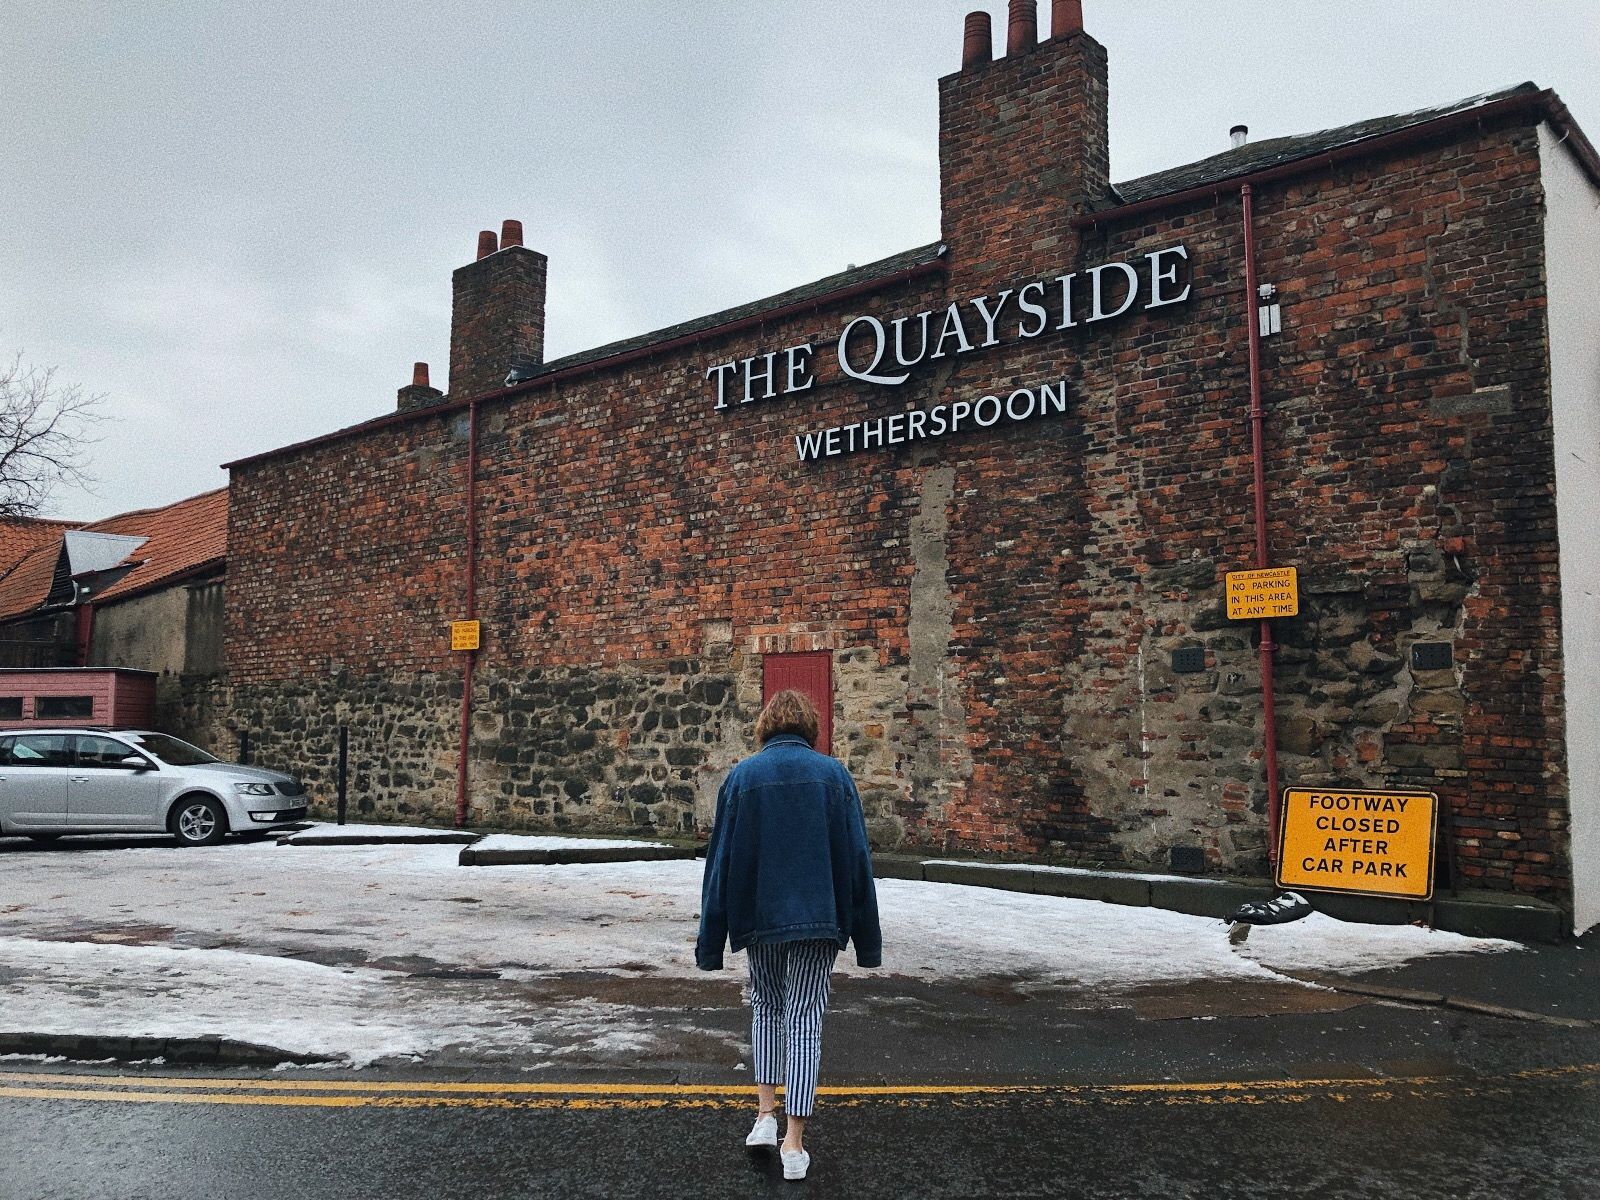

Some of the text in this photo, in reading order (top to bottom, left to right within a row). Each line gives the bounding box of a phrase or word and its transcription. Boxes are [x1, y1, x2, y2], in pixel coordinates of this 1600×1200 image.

[706, 245, 1192, 411] THE QUAYSIDE
[796, 380, 1067, 461] WETHERSPOON
[1252, 580, 1290, 589] PARKING
[1231, 592, 1292, 604] IN THIS AREA
[1232, 605, 1293, 616] AT ANY TIME
[1310, 795, 1409, 813] FOOTWAY
[1316, 816, 1400, 834] CLOSED
[1324, 838, 1388, 855] AFTER
[1302, 857, 1408, 878] CAR PARK
